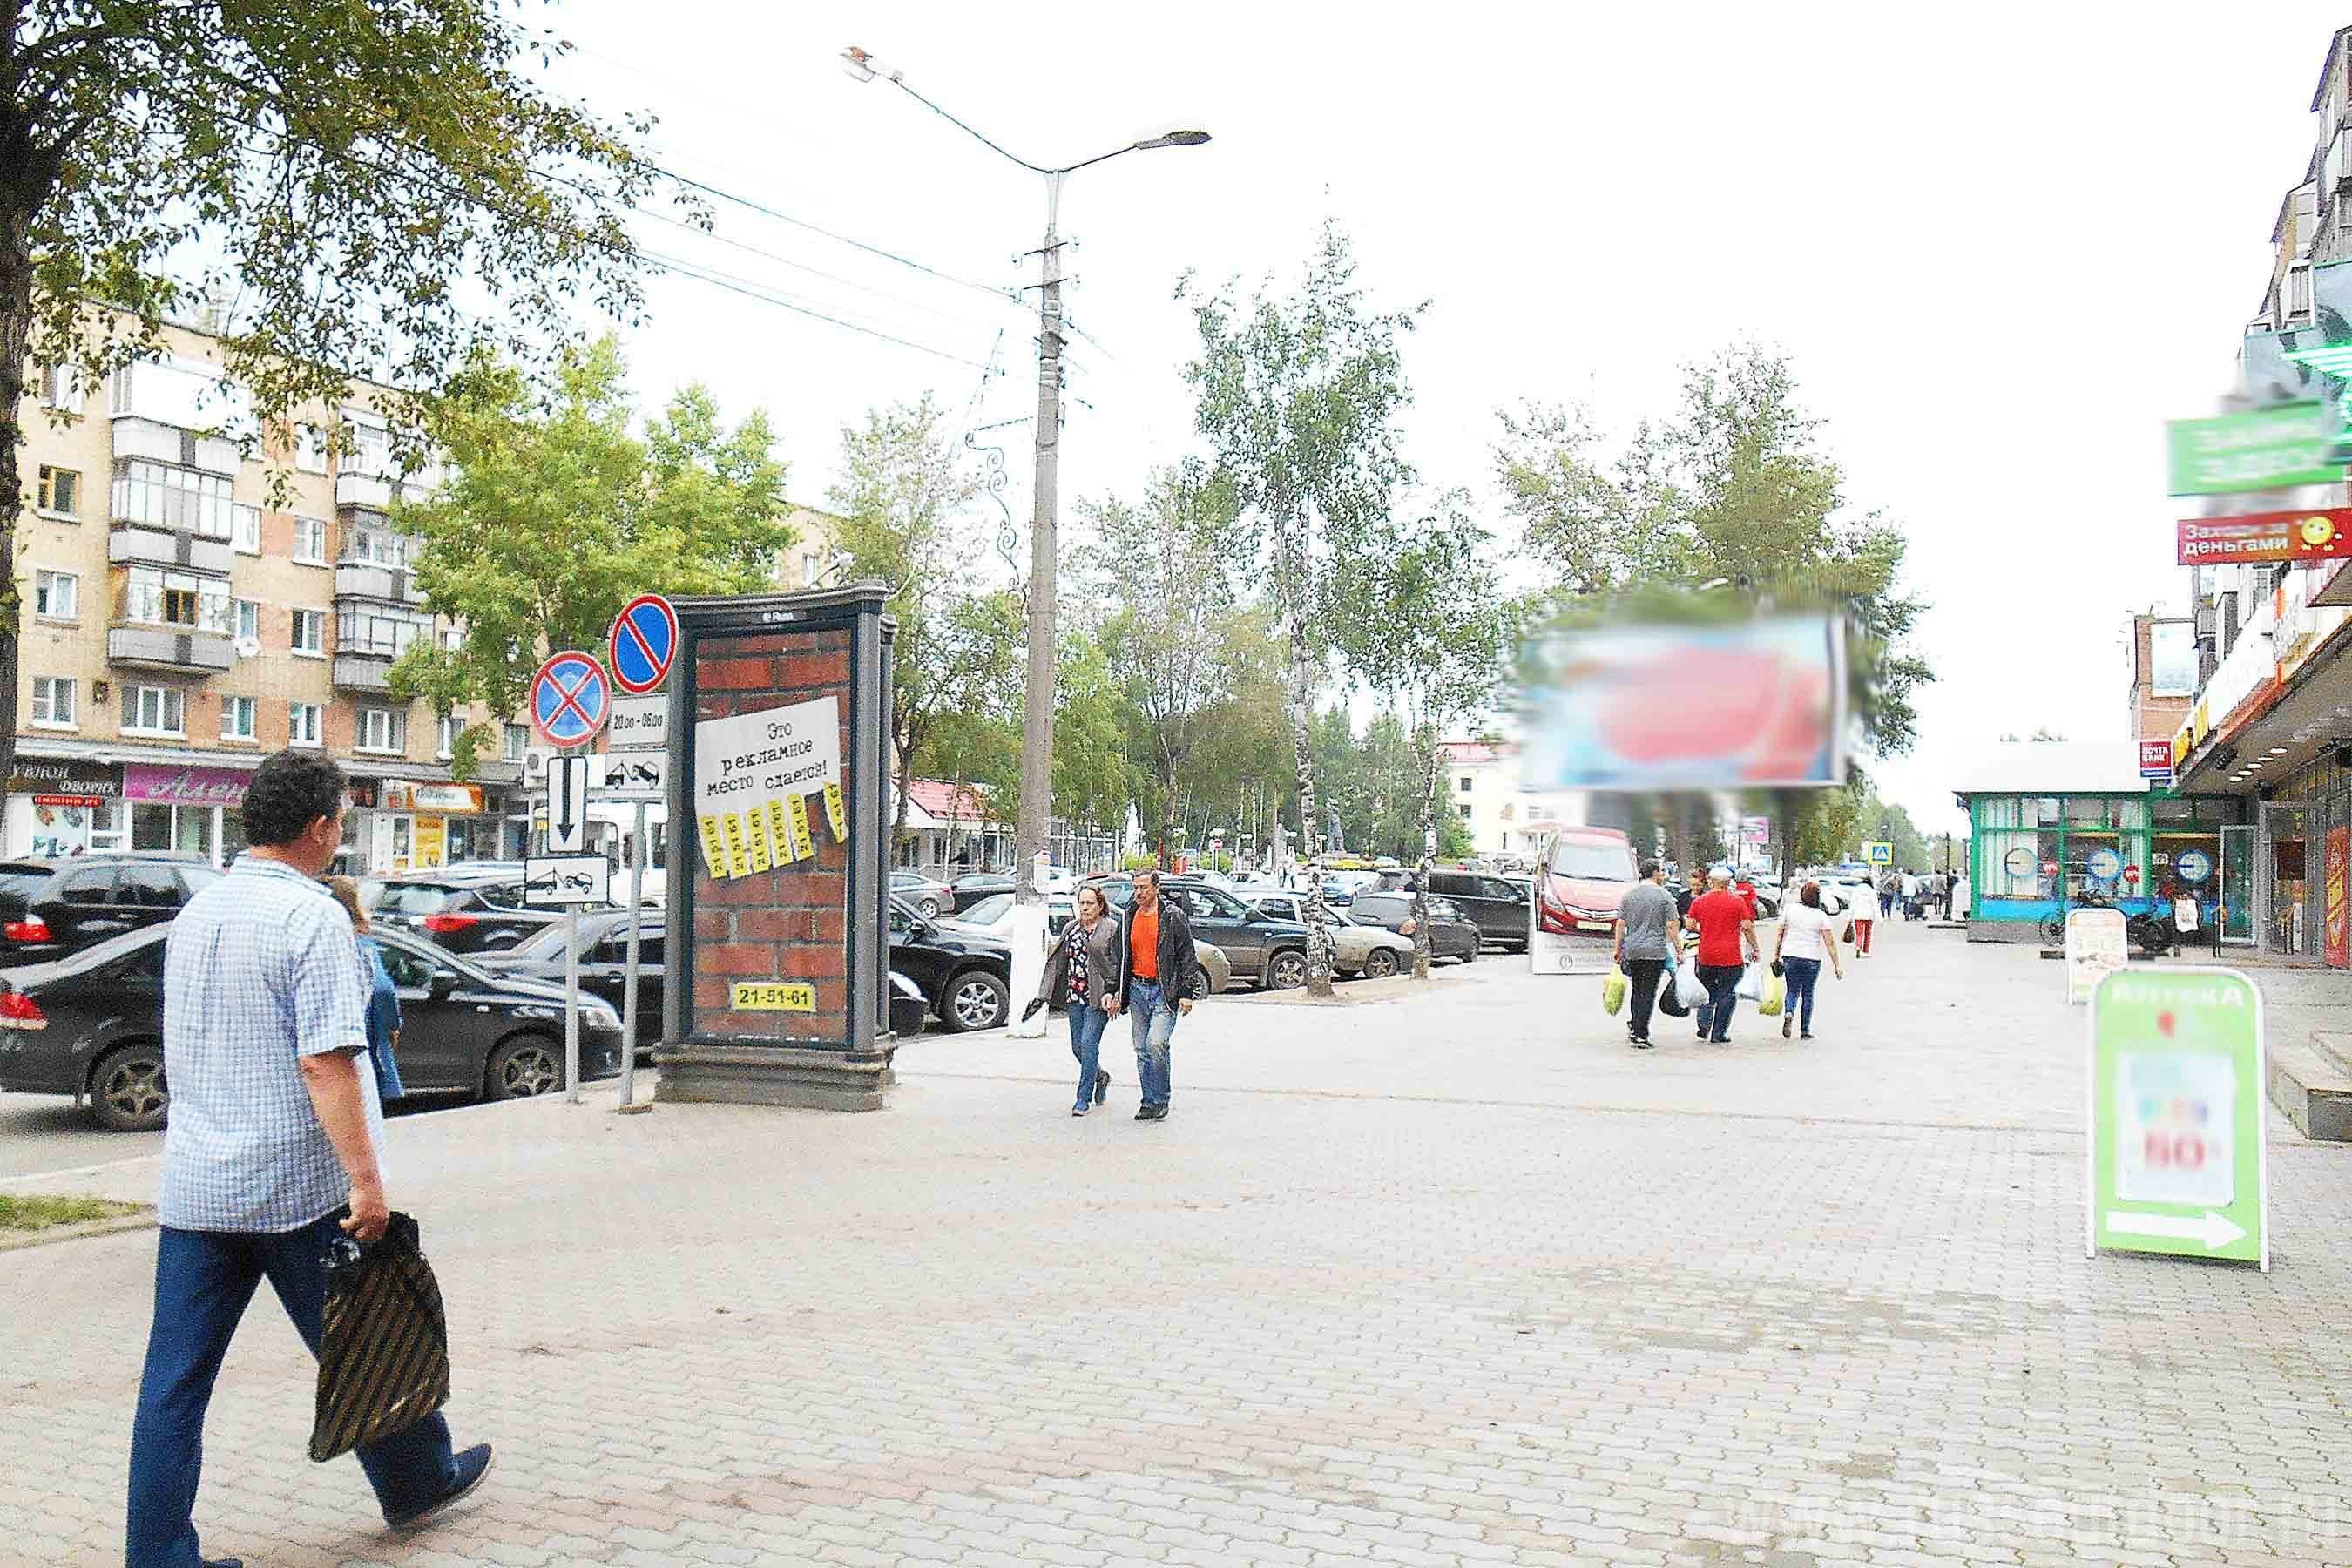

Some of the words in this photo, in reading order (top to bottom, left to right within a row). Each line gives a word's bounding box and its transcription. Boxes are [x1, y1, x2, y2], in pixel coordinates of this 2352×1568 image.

[2184, 538, 2288, 558] деньгами
[767, 722, 793, 740] Это
[721, 740, 814, 776] рекламное
[706, 775, 754, 796] место
[765, 760, 828, 789] сдается!
[739, 989, 808, 1004] 21-51-61
